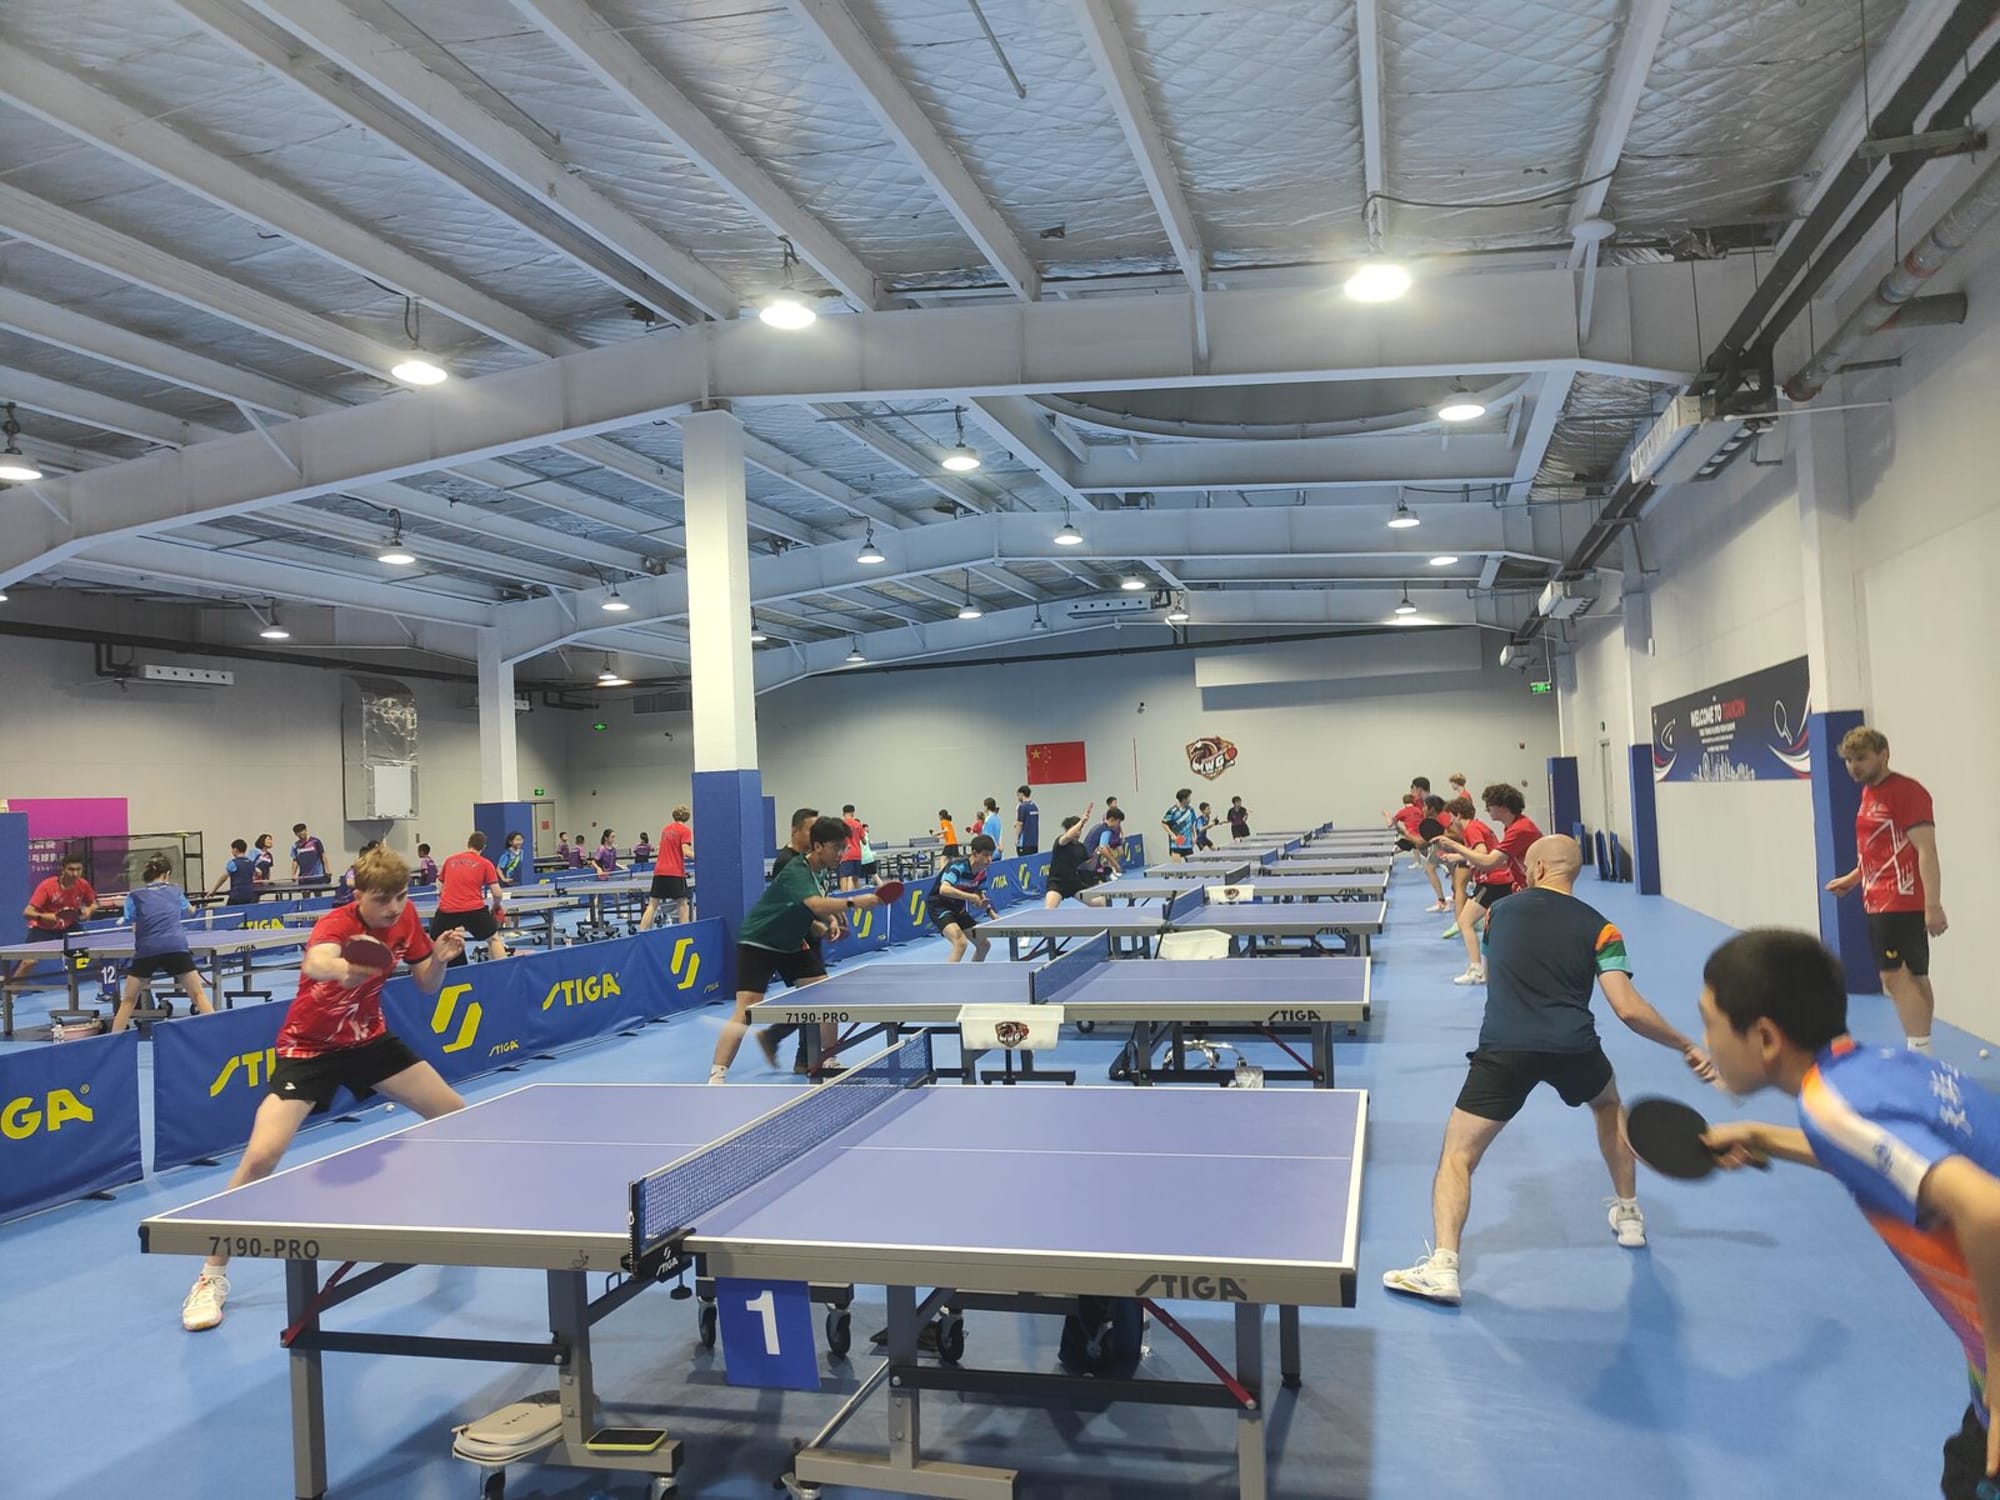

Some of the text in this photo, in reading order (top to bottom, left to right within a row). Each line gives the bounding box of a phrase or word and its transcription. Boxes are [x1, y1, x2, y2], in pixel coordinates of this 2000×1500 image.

[1690, 705, 1714, 728] WELCOME
[1714, 703, 1722, 723] TO
[1316, 927, 1350, 936] STIGA
[101, 965, 116, 984] 12
[543, 973, 621, 1011] STIGA
[785, 1011, 849, 1023] 7190-PRO
[1268, 1010, 1321, 1021] STIGA
[488, 1040, 520, 1057] STIGA
[210, 1048, 276, 1097] STI
[209, 1236, 320, 1259] 7190-PRO
[656, 1256, 680, 1276] STIGA
[1135, 1274, 1248, 1301] STIGA
[745, 1289, 780, 1356] 1
